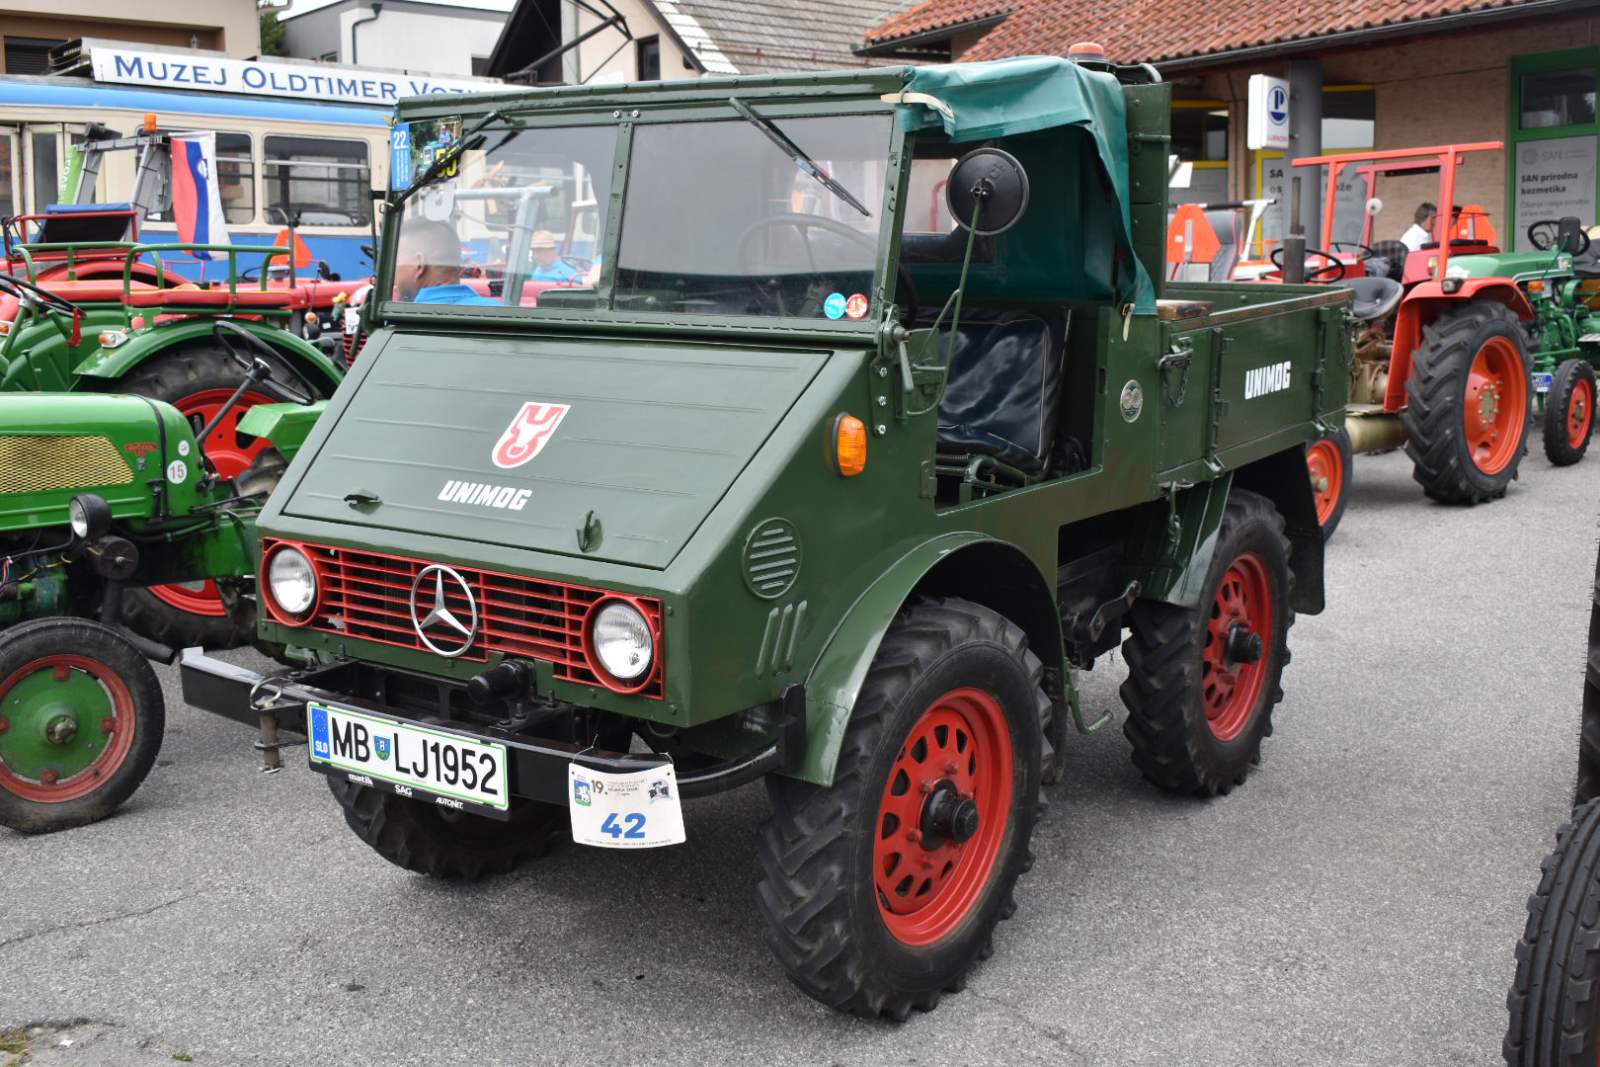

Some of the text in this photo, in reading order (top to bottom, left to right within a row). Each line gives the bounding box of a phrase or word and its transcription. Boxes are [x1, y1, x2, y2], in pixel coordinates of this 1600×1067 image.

[393, 131, 407, 149] 22
[1244, 360, 1292, 400] UNIMOG
[170, 465, 184, 479] 15
[437, 480, 533, 511] UNIMOG
[314, 740, 328, 753] SLO
[331, 716, 499, 796] MB LJ1952
[394, 784, 412, 797] SAG
[600, 812, 647, 839] 42
